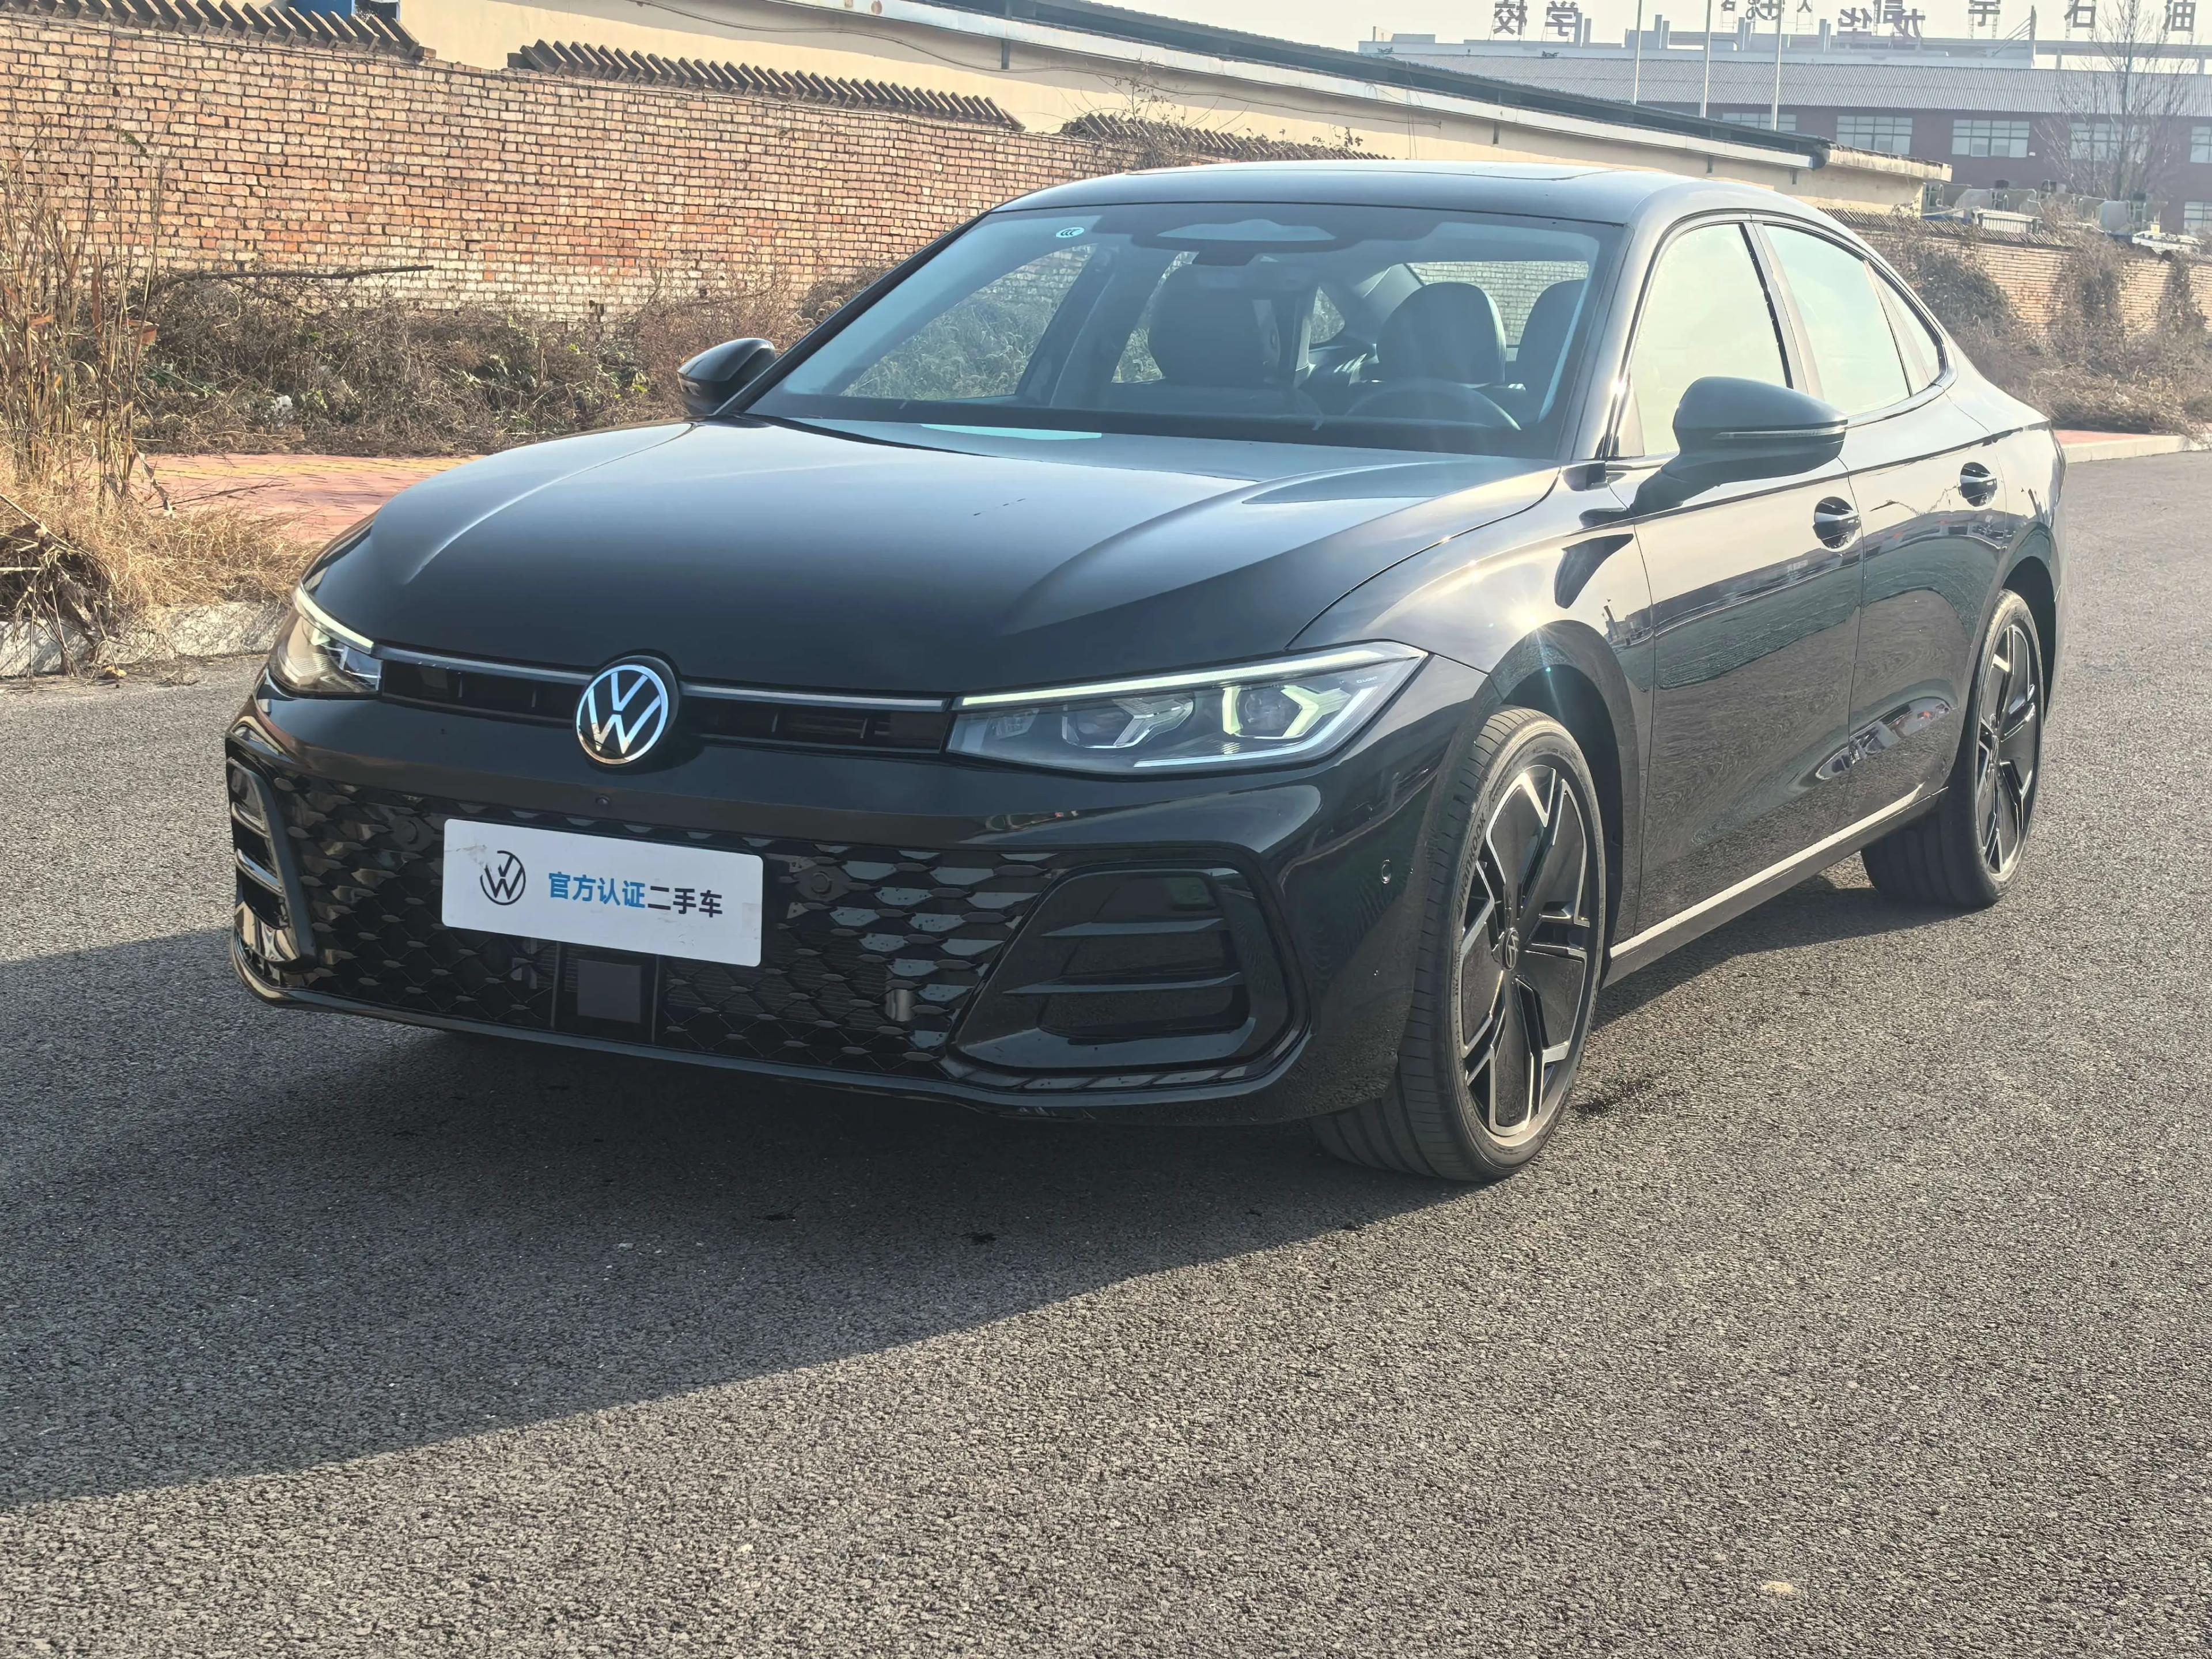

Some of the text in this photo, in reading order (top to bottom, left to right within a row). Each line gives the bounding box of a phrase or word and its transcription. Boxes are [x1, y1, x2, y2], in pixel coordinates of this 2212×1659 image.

[585, 669, 662, 756] VW
[548, 872, 723, 918] 官方认证二手车
